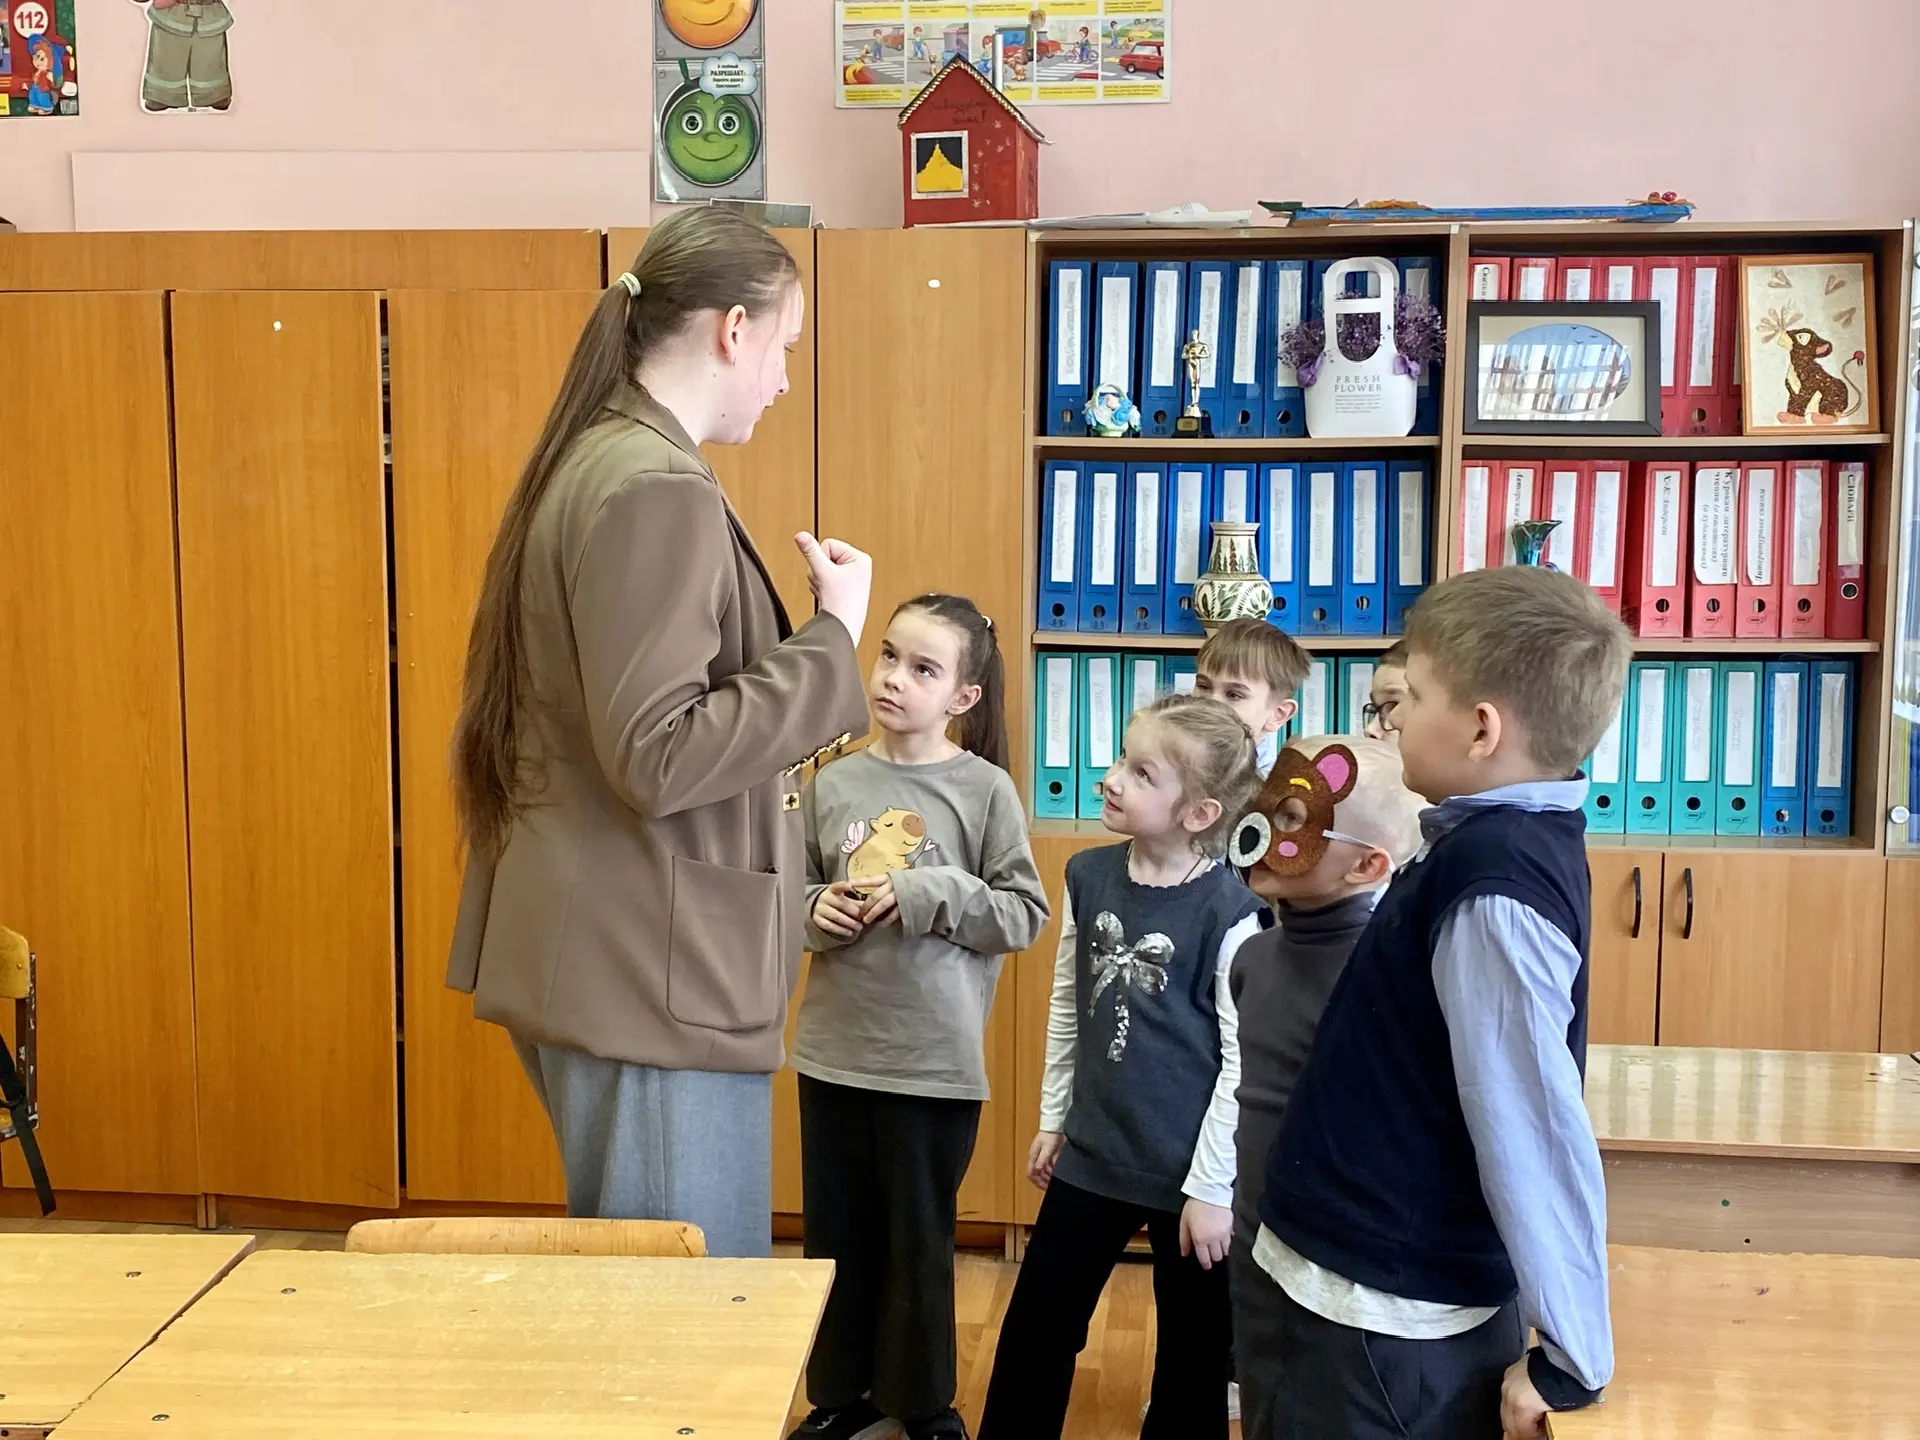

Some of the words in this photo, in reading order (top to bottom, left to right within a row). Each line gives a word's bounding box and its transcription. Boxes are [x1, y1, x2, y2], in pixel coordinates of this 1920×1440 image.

[16, 11, 45, 29] 112
[1334, 384, 1382, 392] FLOWER
[1336, 375, 1380, 383] FRESH
[1847, 474, 1855, 522] СЛОВАРИ
[1754, 518, 1766, 583] Литературные
